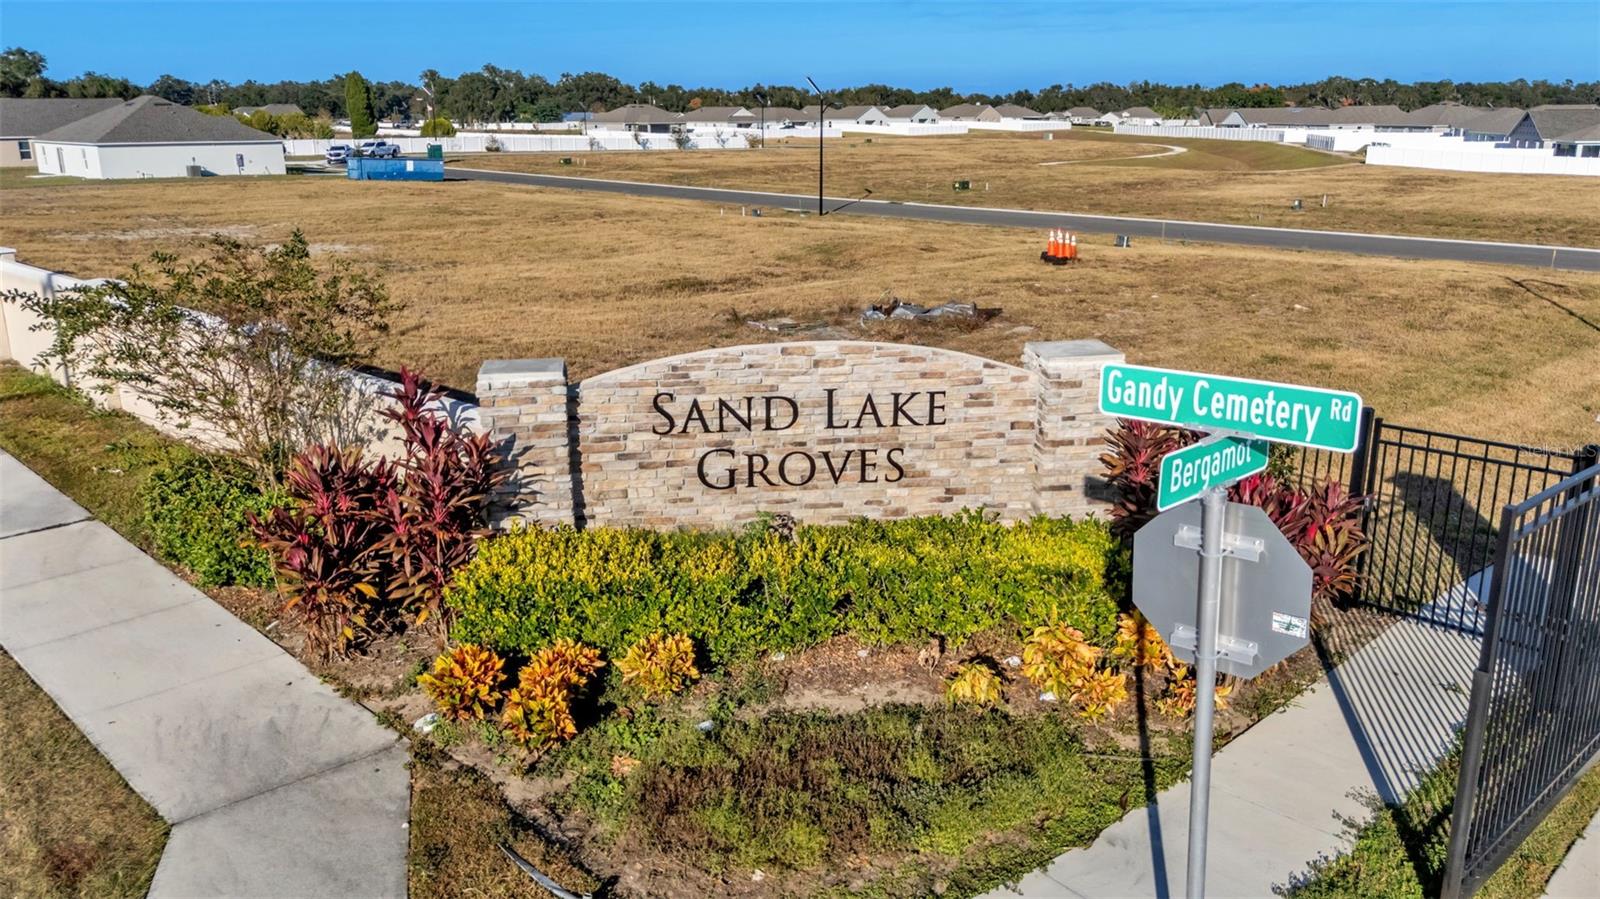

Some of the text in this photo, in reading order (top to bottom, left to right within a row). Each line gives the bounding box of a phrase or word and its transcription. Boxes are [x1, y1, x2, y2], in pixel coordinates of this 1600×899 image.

[652, 388, 947, 435] SAND LAKE
[1107, 369, 1352, 442] Gandy Cemetery Rd
[697, 448, 905, 490] GROVES
